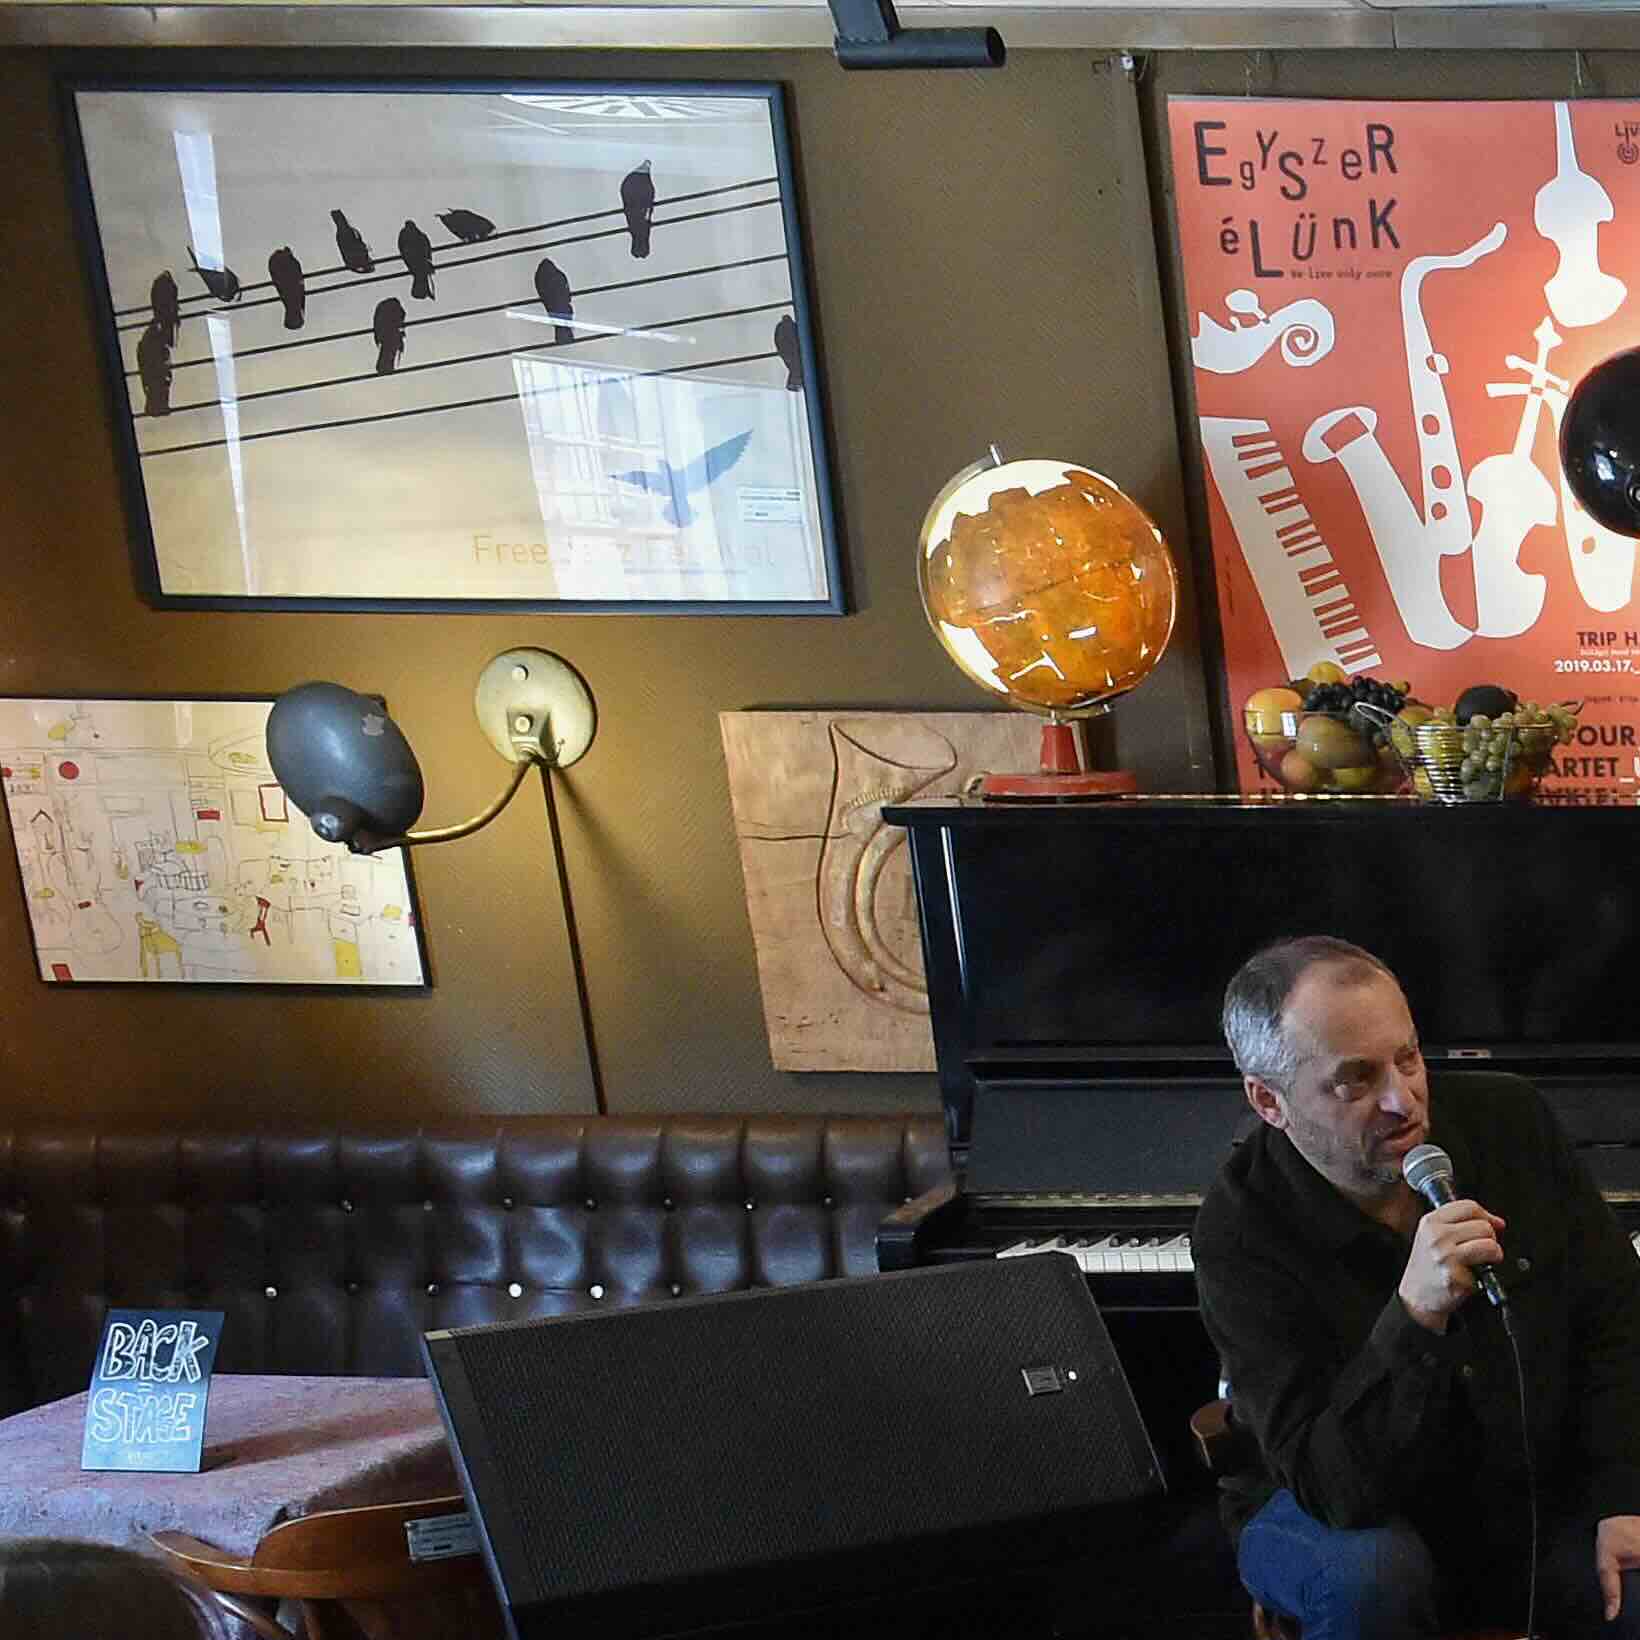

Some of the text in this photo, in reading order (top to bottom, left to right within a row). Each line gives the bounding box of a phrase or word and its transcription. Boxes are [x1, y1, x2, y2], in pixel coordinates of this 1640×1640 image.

[1576, 631, 1617, 647] TRIP
[100, 1318, 209, 1384] BACK
[90, 1387, 197, 1444] STAGE
